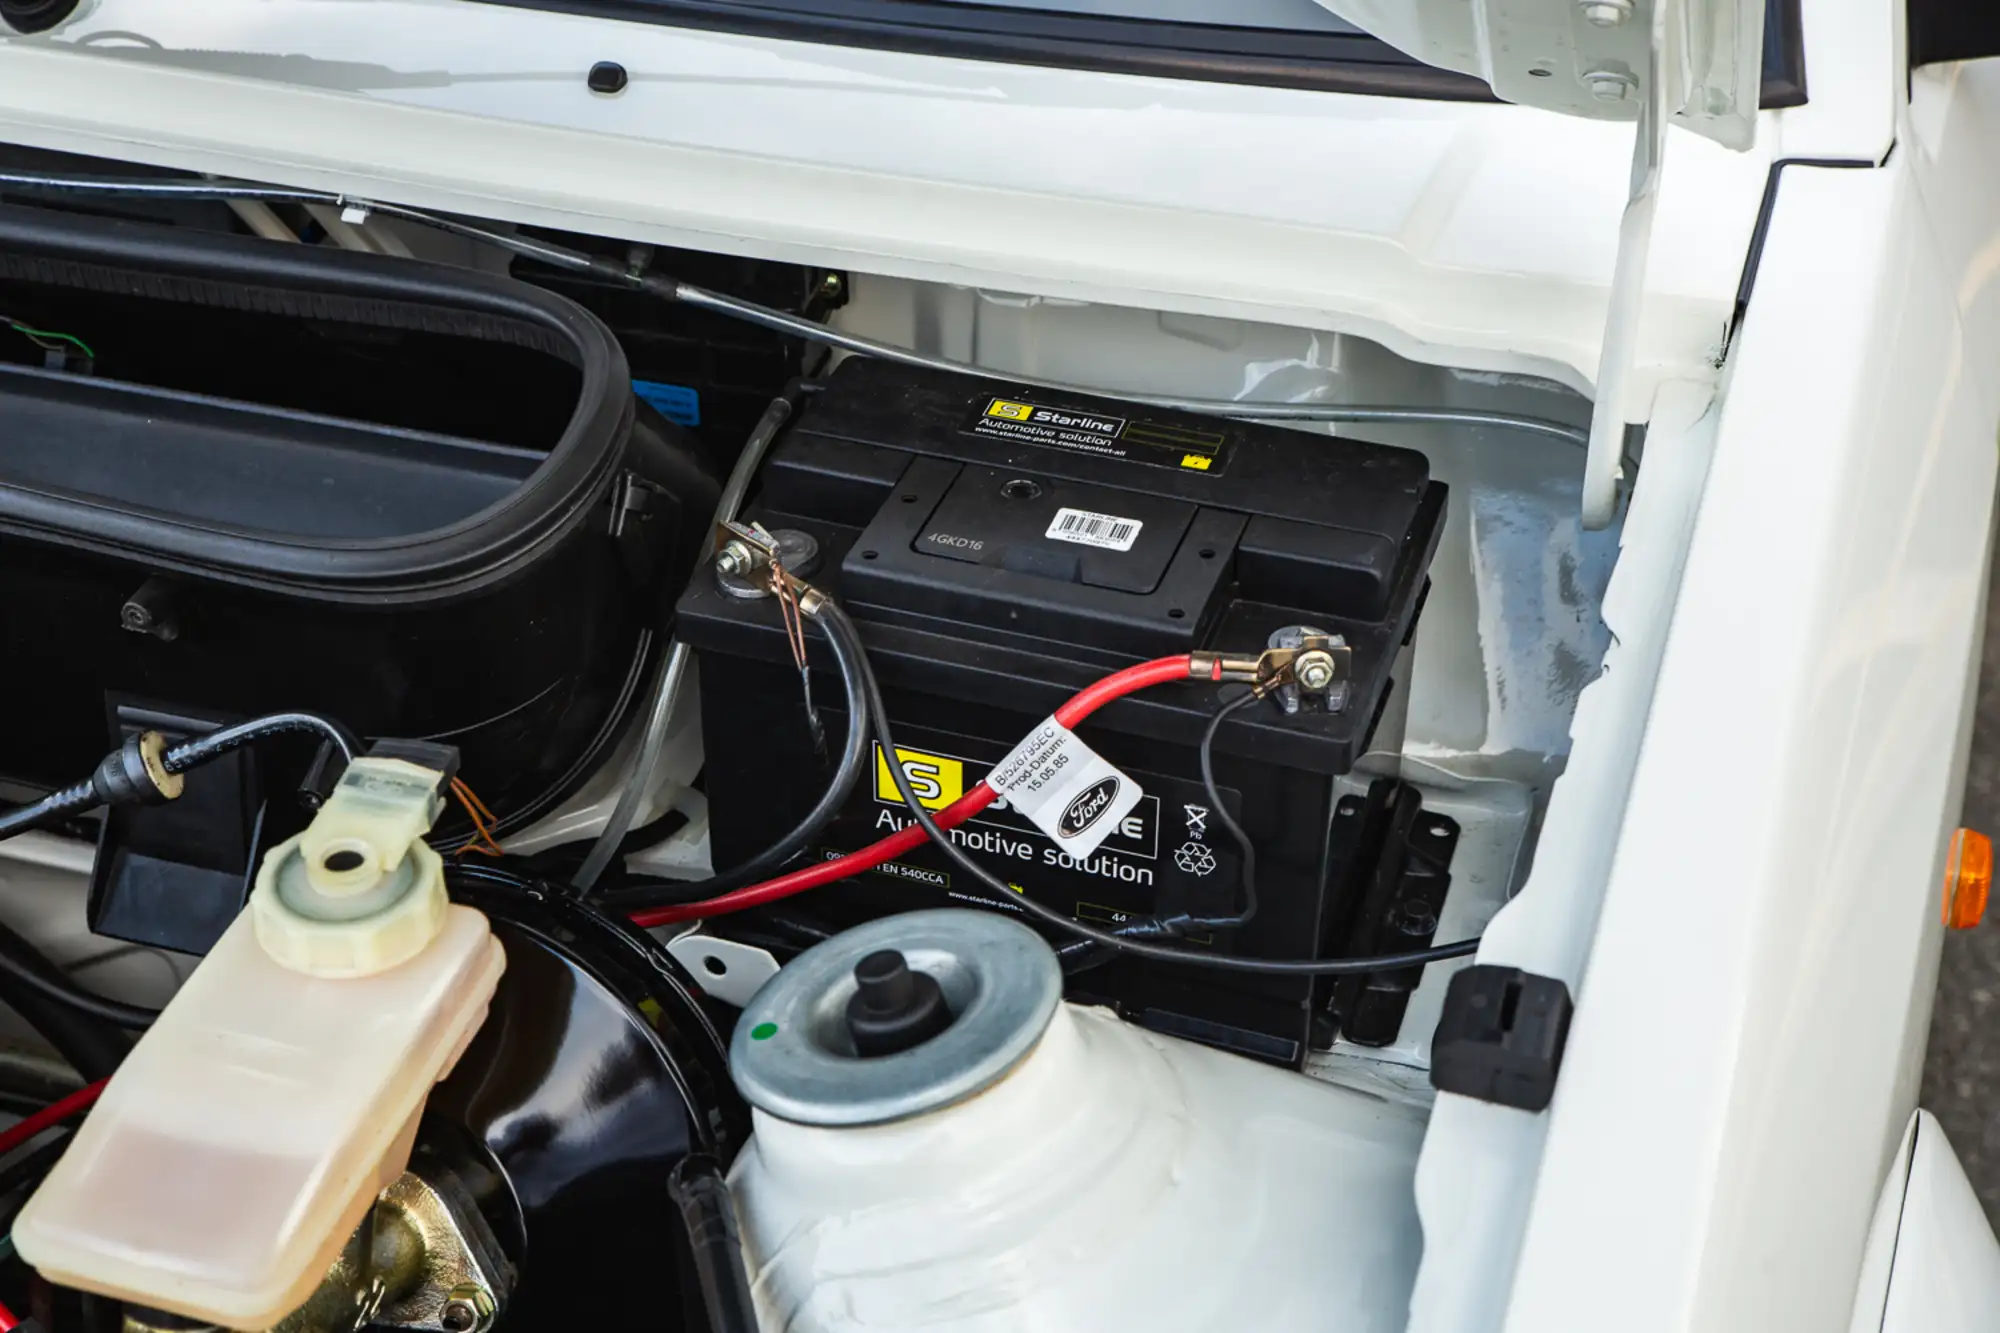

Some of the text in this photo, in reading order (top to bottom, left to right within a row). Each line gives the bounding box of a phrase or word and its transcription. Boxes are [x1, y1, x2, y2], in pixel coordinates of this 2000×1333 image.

[978, 418, 1112, 447] Automotive solution
[998, 403, 1114, 433] S Starline
[927, 532, 984, 551] 4GKD16
[900, 759, 942, 800] S
[1006, 737, 1067, 792] Prod-Datum:
[1026, 752, 1070, 793] 15.05.85
[1069, 787, 1110, 828] Ford
[875, 808, 1034, 861] Aumotive
[882, 863, 899, 874] EN
[900, 866, 945, 885] 540CCA
